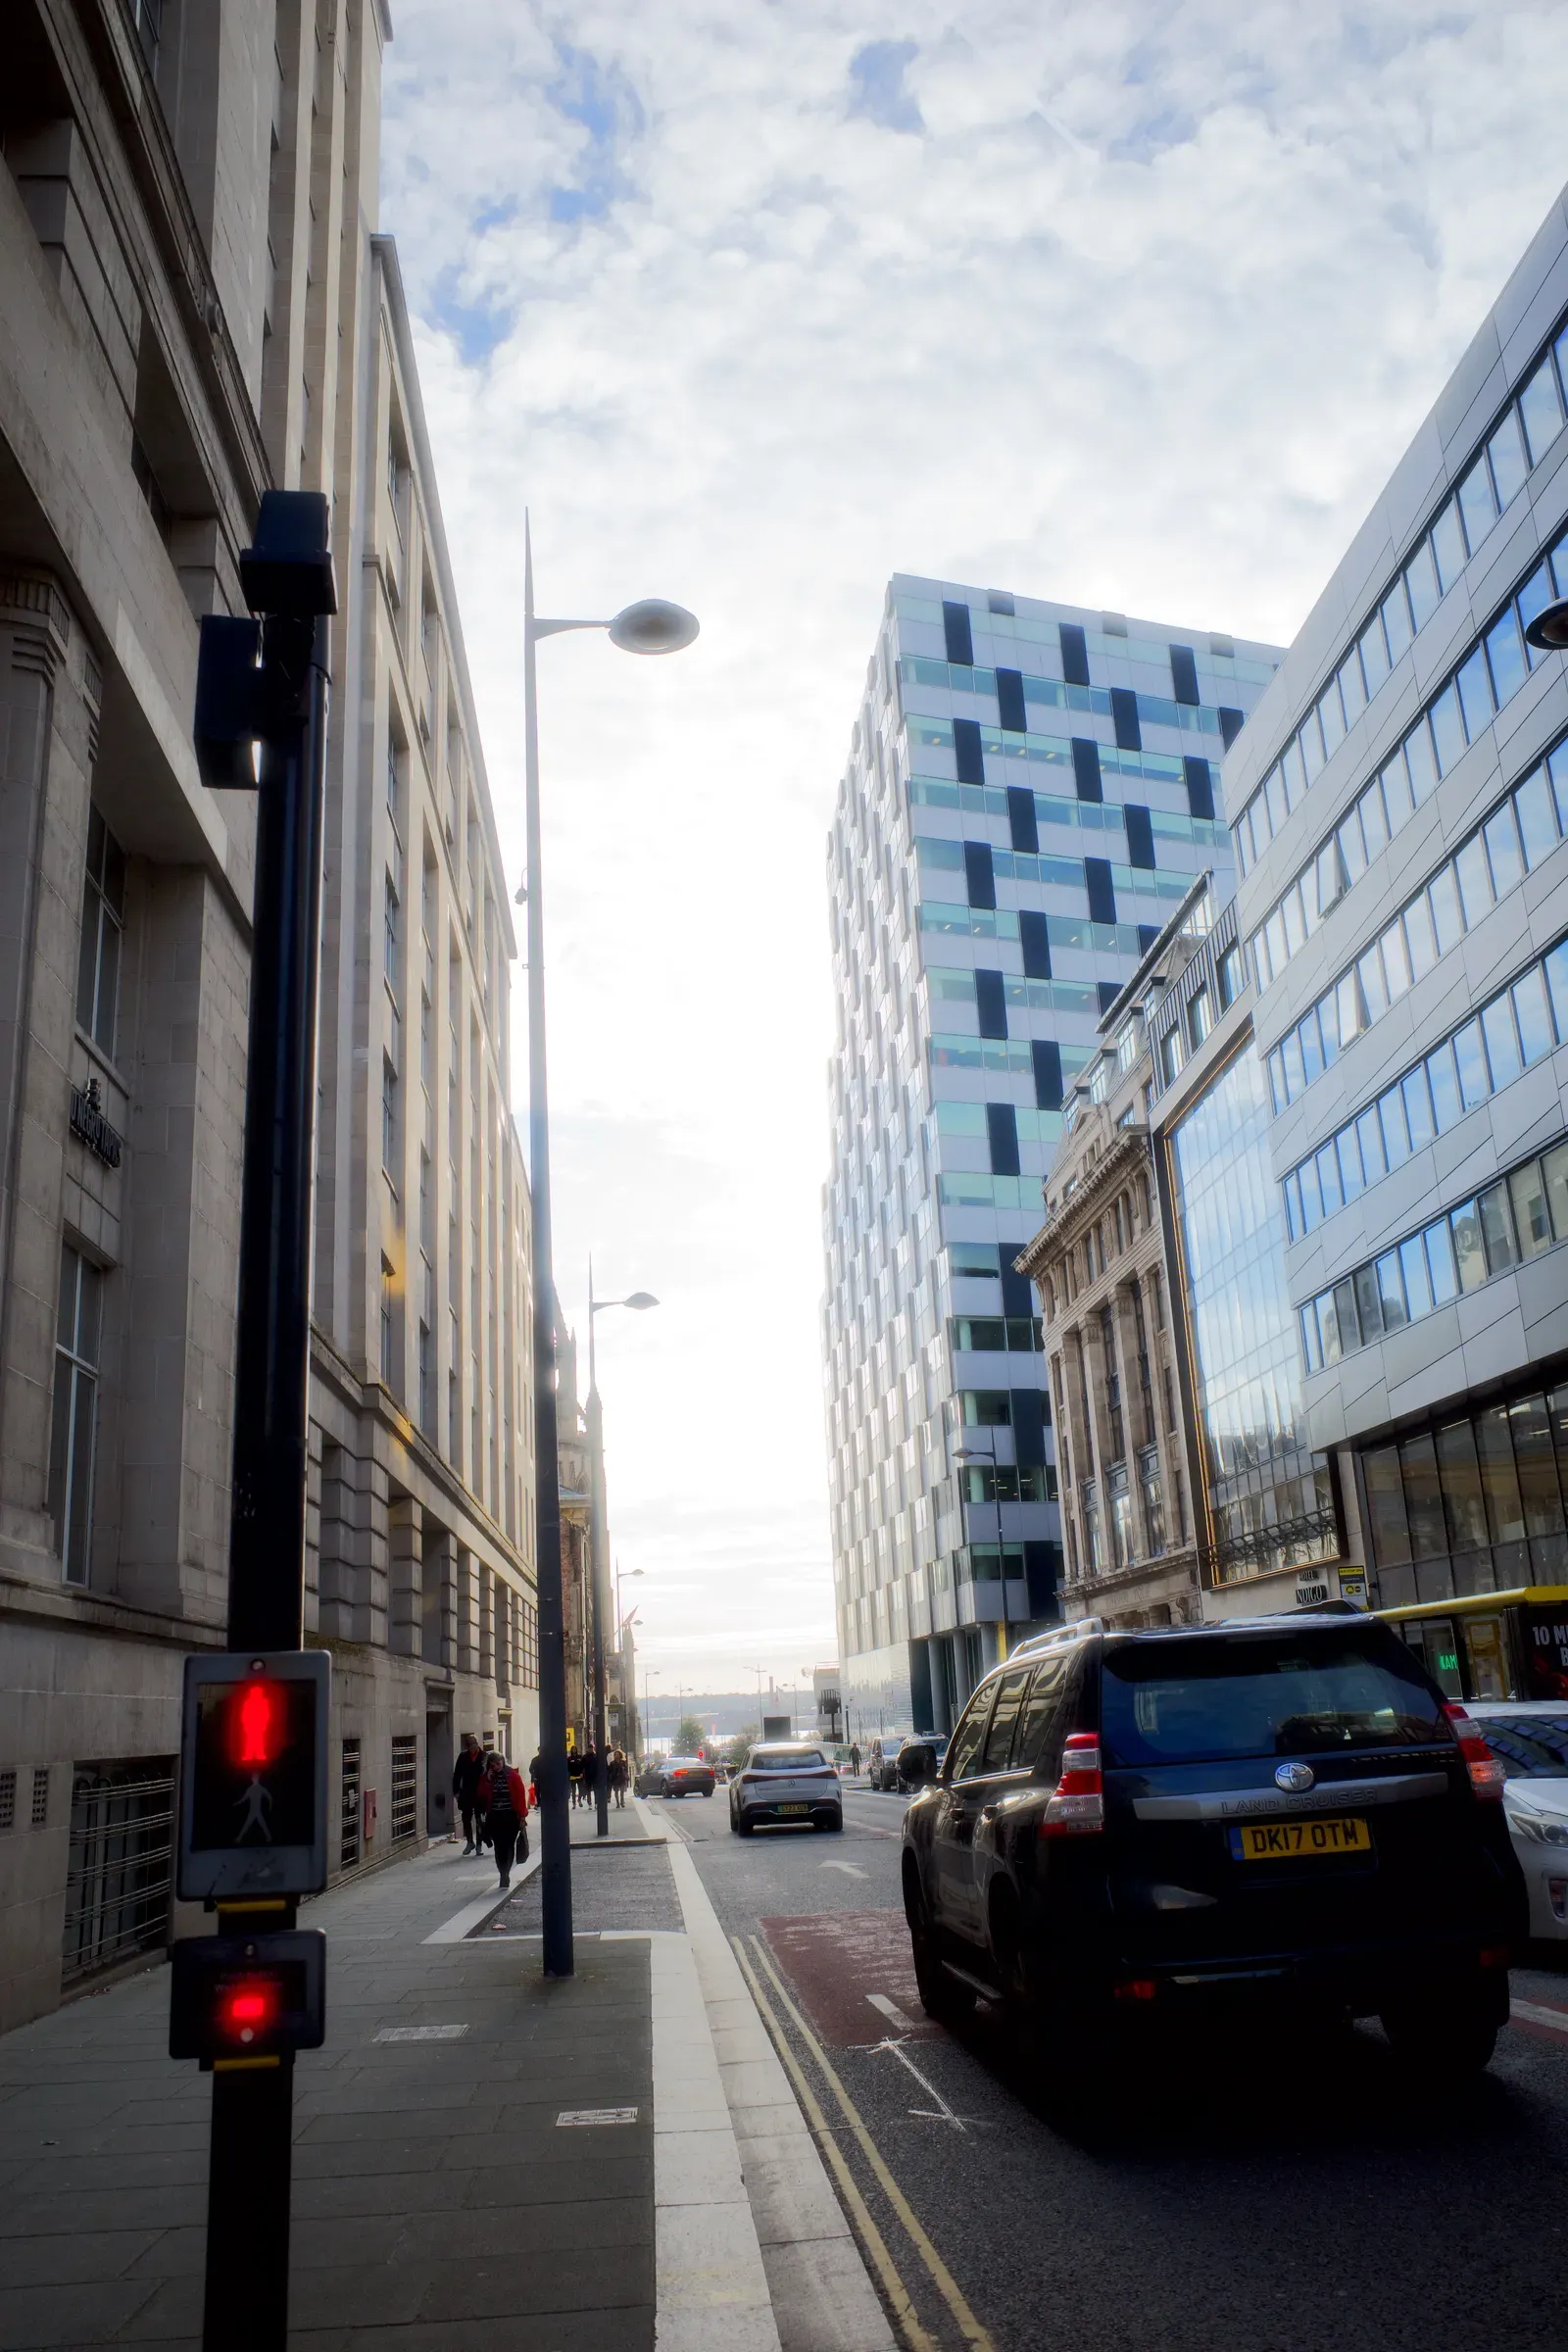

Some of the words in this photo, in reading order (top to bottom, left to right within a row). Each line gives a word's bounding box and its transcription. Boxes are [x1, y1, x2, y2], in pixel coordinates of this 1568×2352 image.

[1532, 1625, 1550, 1645] 10
[1553, 1625, 1568, 1644] M
[1221, 1798, 1280, 1815] LAND
[1286, 1788, 1377, 1810] CRUISER
[1250, 1827, 1303, 1853] DK17
[1311, 1820, 1359, 1848] OTM
